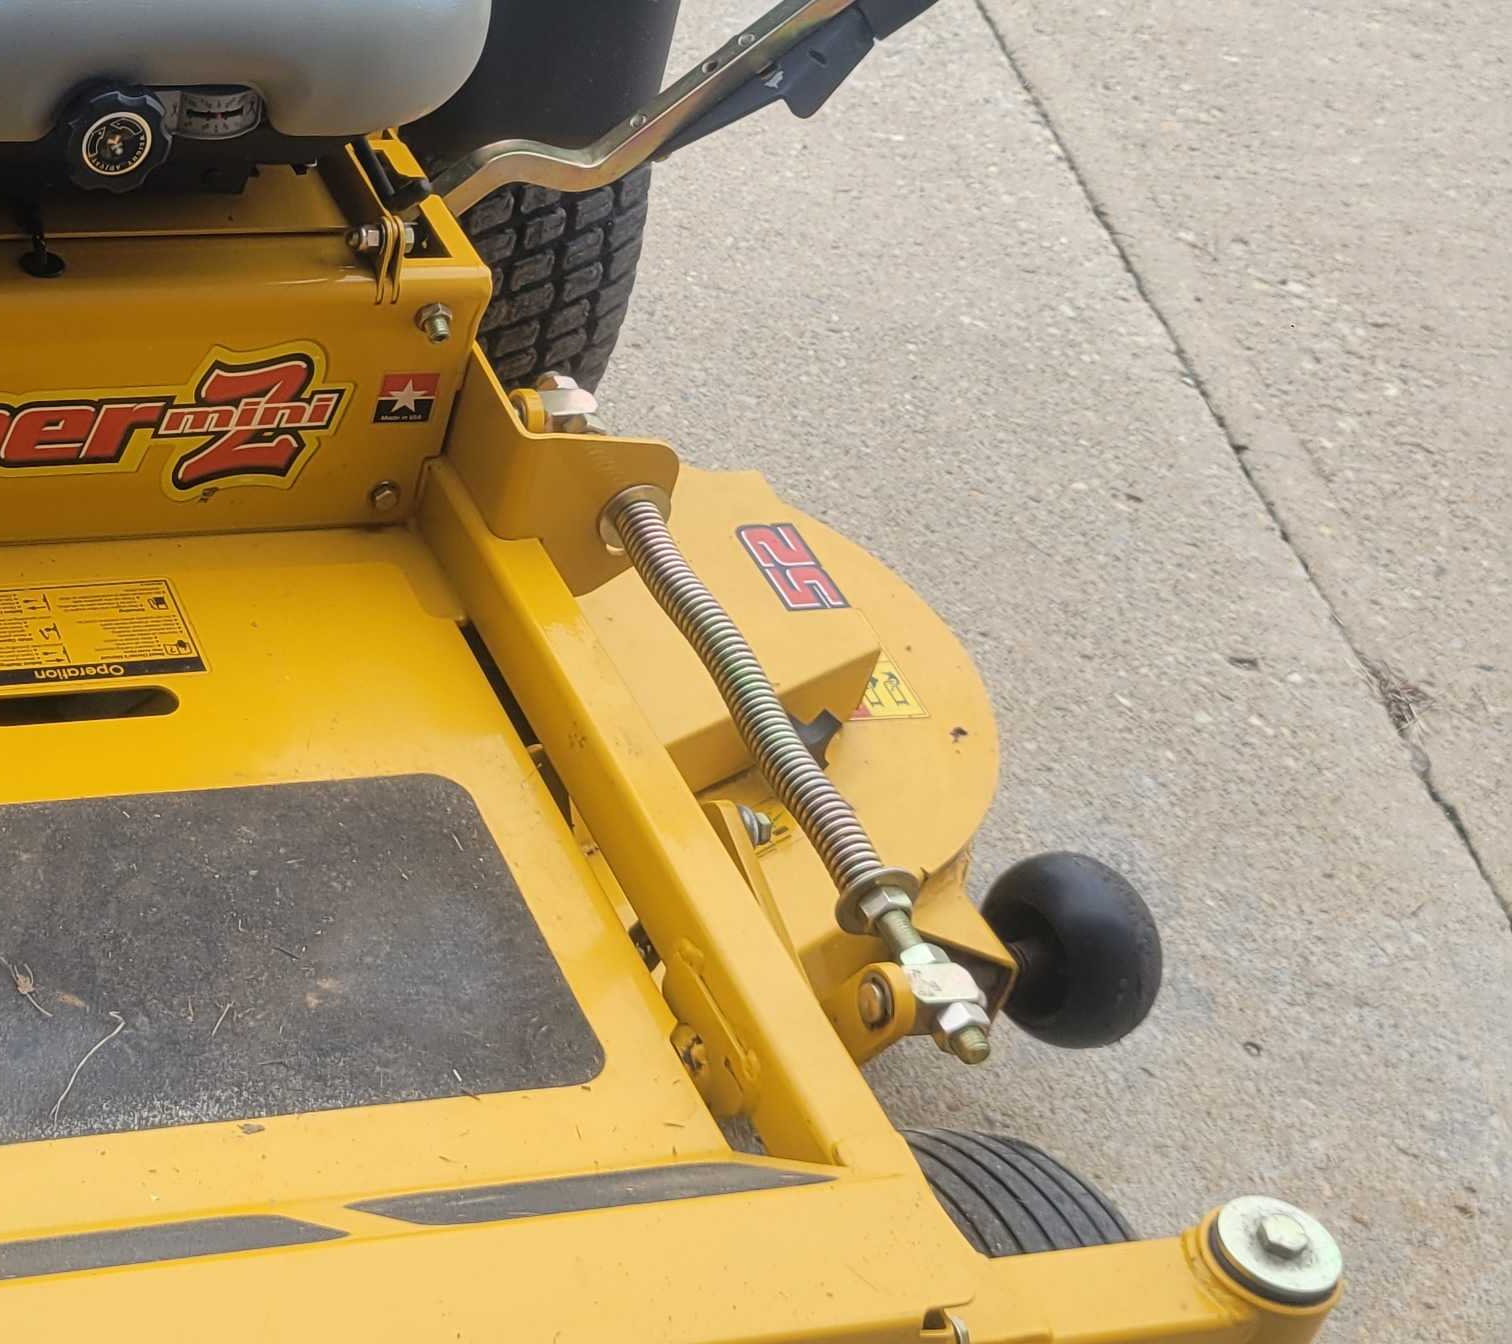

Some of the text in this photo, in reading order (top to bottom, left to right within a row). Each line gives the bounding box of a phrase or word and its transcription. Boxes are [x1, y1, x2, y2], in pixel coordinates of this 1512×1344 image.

[159, 393, 339, 437] mini
[176, 360, 307, 487] Z
[739, 524, 845, 608] 25
[34, 664, 125, 680] Operation
